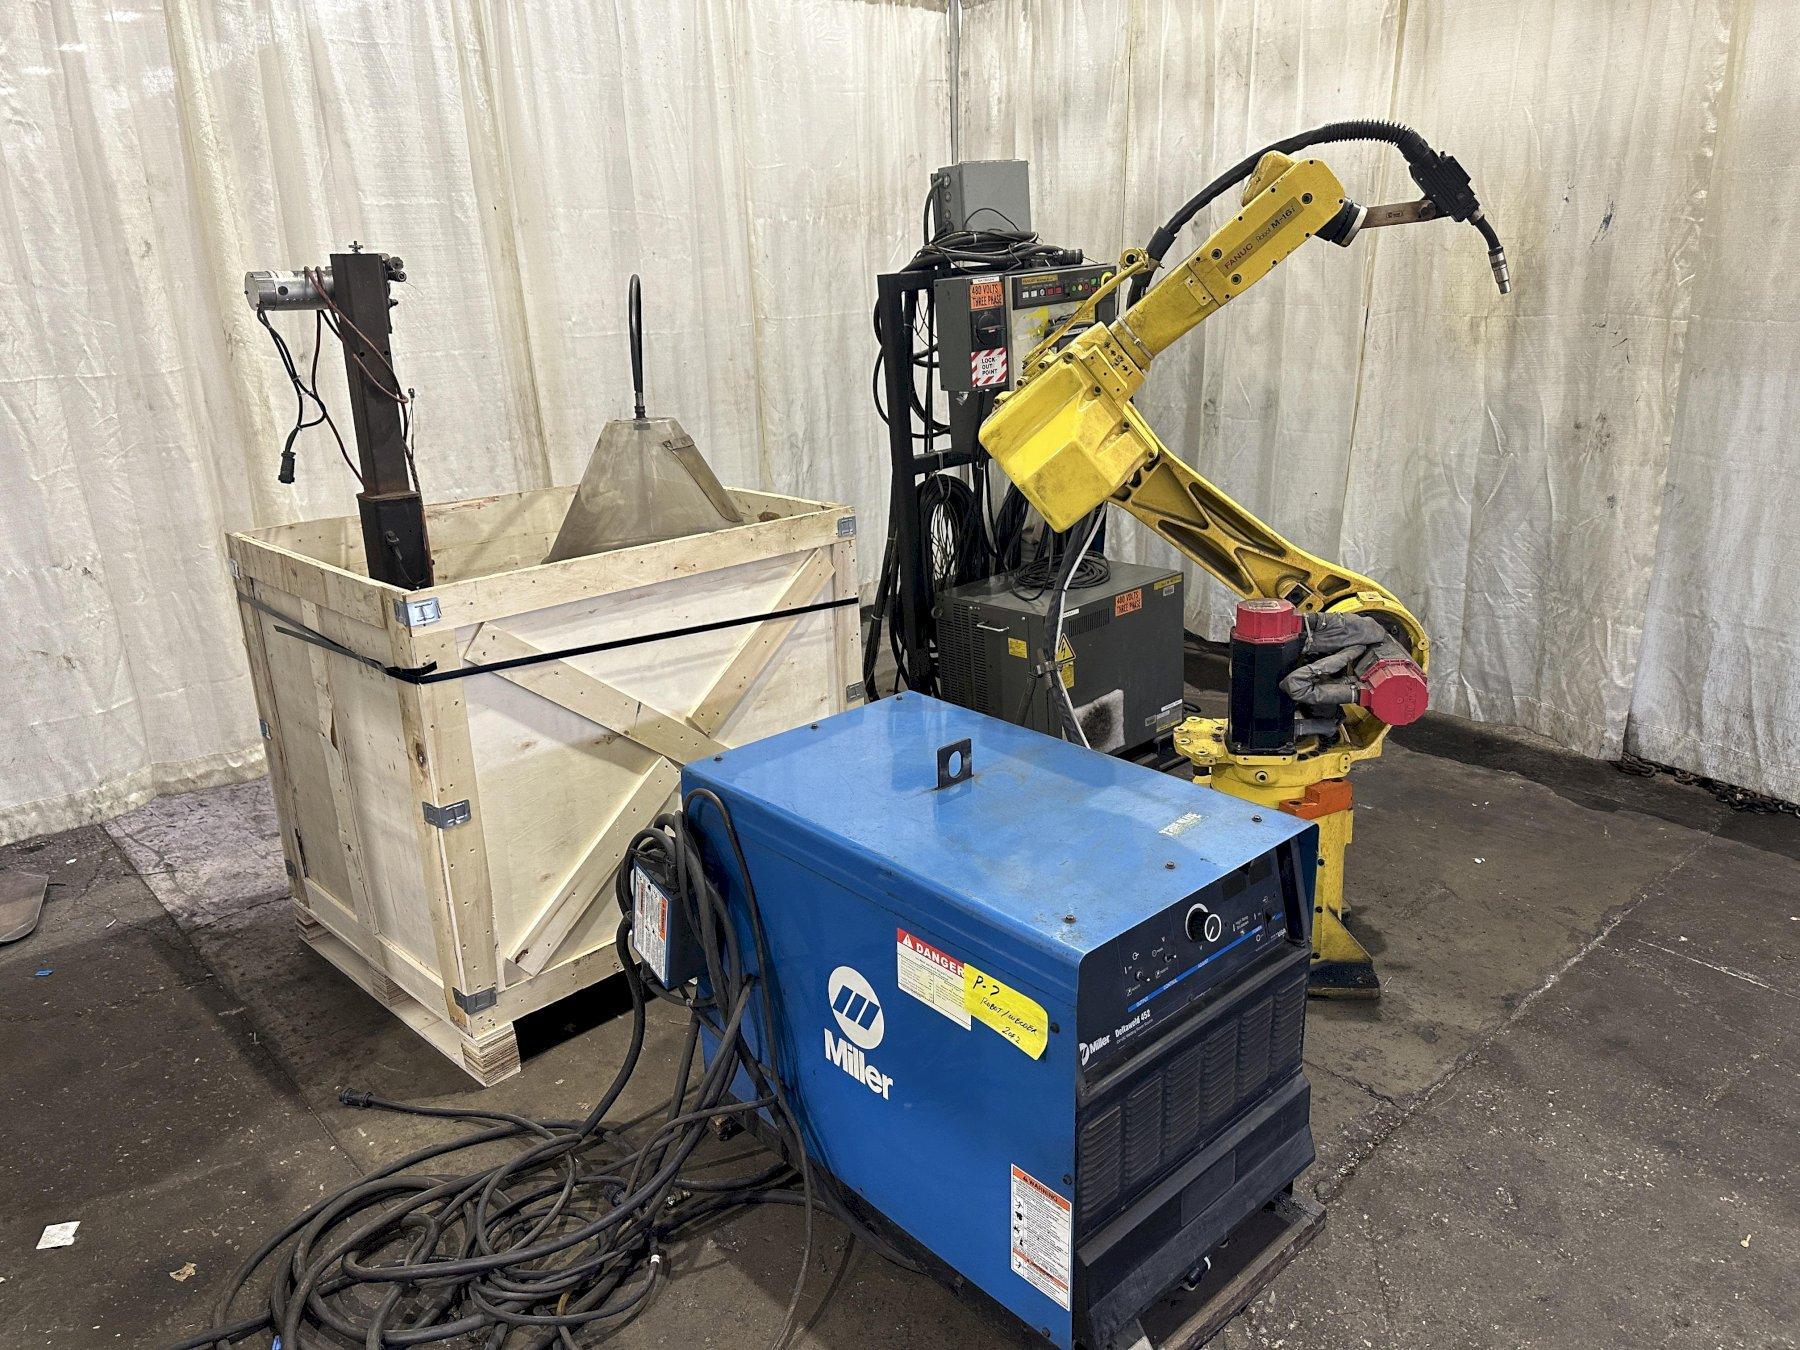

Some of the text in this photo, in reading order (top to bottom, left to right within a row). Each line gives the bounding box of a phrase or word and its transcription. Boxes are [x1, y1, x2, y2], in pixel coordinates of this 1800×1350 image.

[1224, 243, 1253, 269] FANUC
[972, 284, 999, 295] 480 VOLTS
[972, 295, 1002, 307] THREE PHASE
[1116, 591, 1139, 605] 480 VOLTS
[1116, 600, 1141, 614] THREE PHASE
[916, 942, 965, 977] DANGER
[1089, 1008, 1151, 1055] Miller Deltaweld 452
[824, 1028, 894, 1101] Miller
